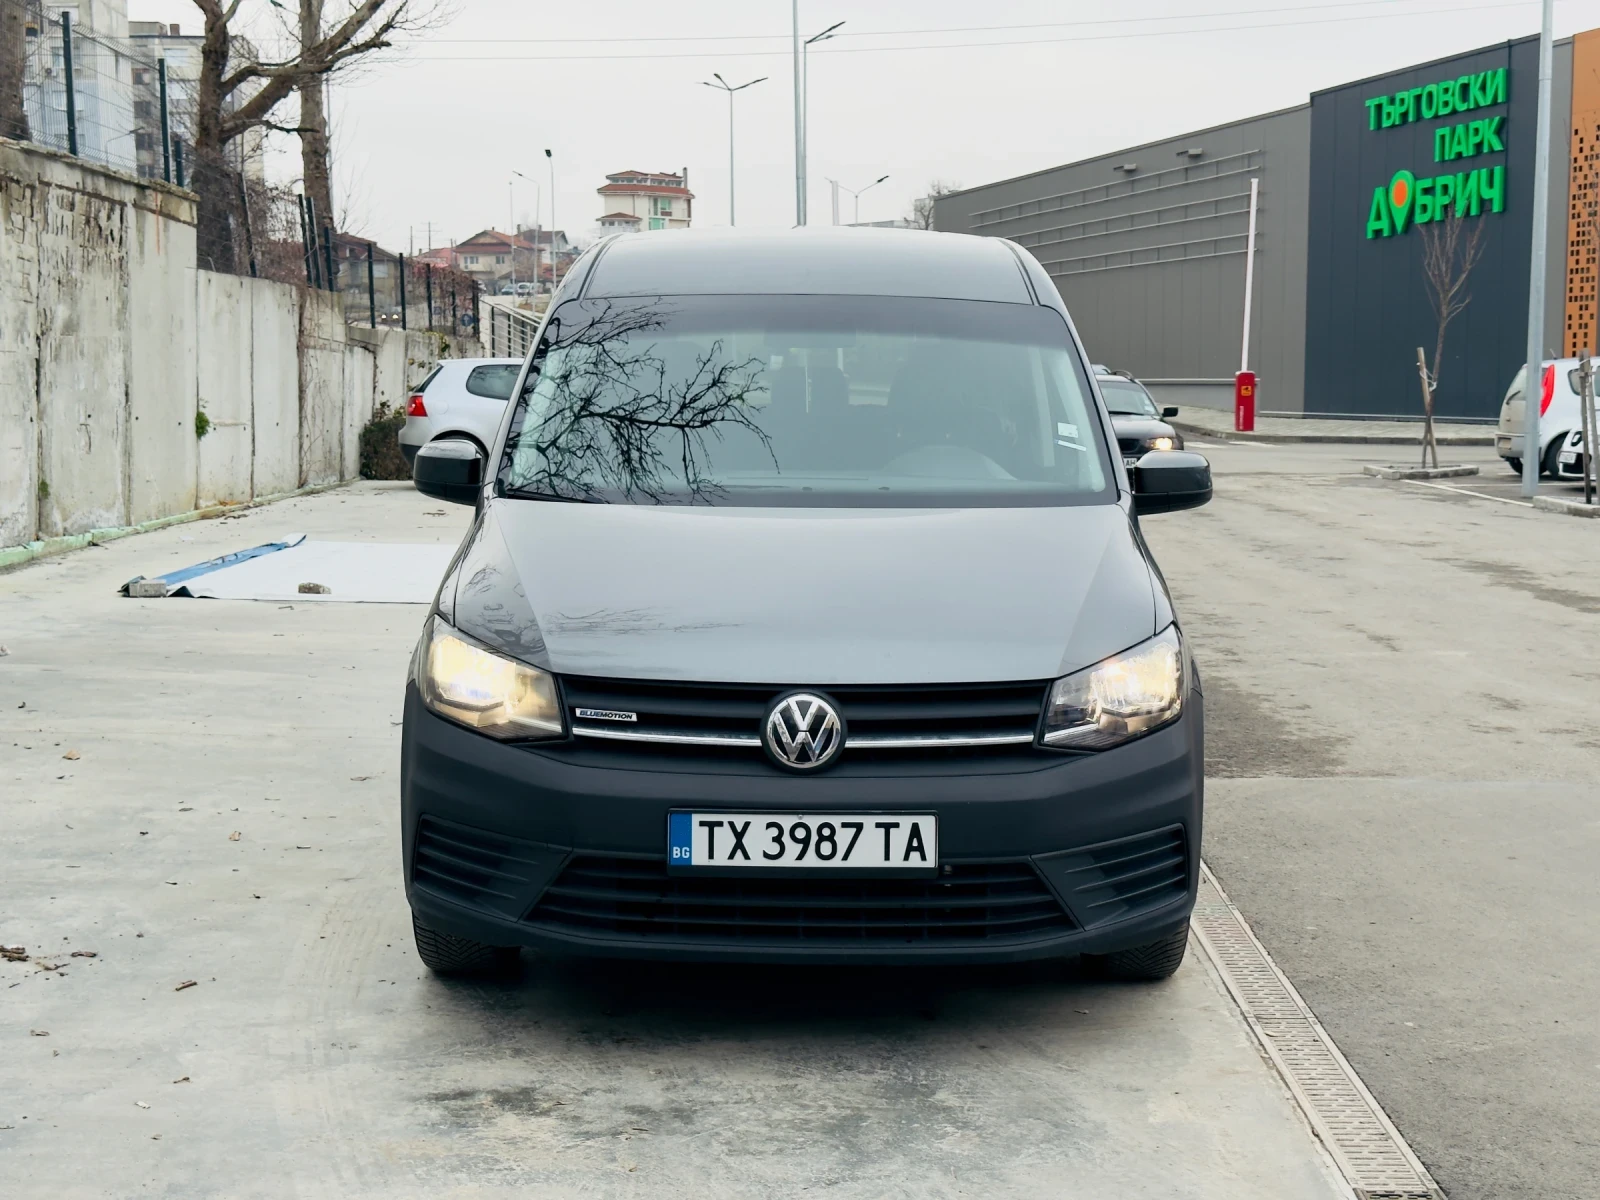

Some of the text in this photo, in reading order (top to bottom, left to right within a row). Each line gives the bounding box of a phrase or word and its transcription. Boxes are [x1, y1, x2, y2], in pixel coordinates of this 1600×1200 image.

[1365, 68, 1507, 131] ТЪРГОВСКИ
[1435, 116, 1506, 163] ПАРК
[579, 709, 633, 720] BLUEMOTION
[766, 693, 841, 768] VW
[672, 846, 690, 859] BG
[698, 820, 928, 862] TX 3987 TA
